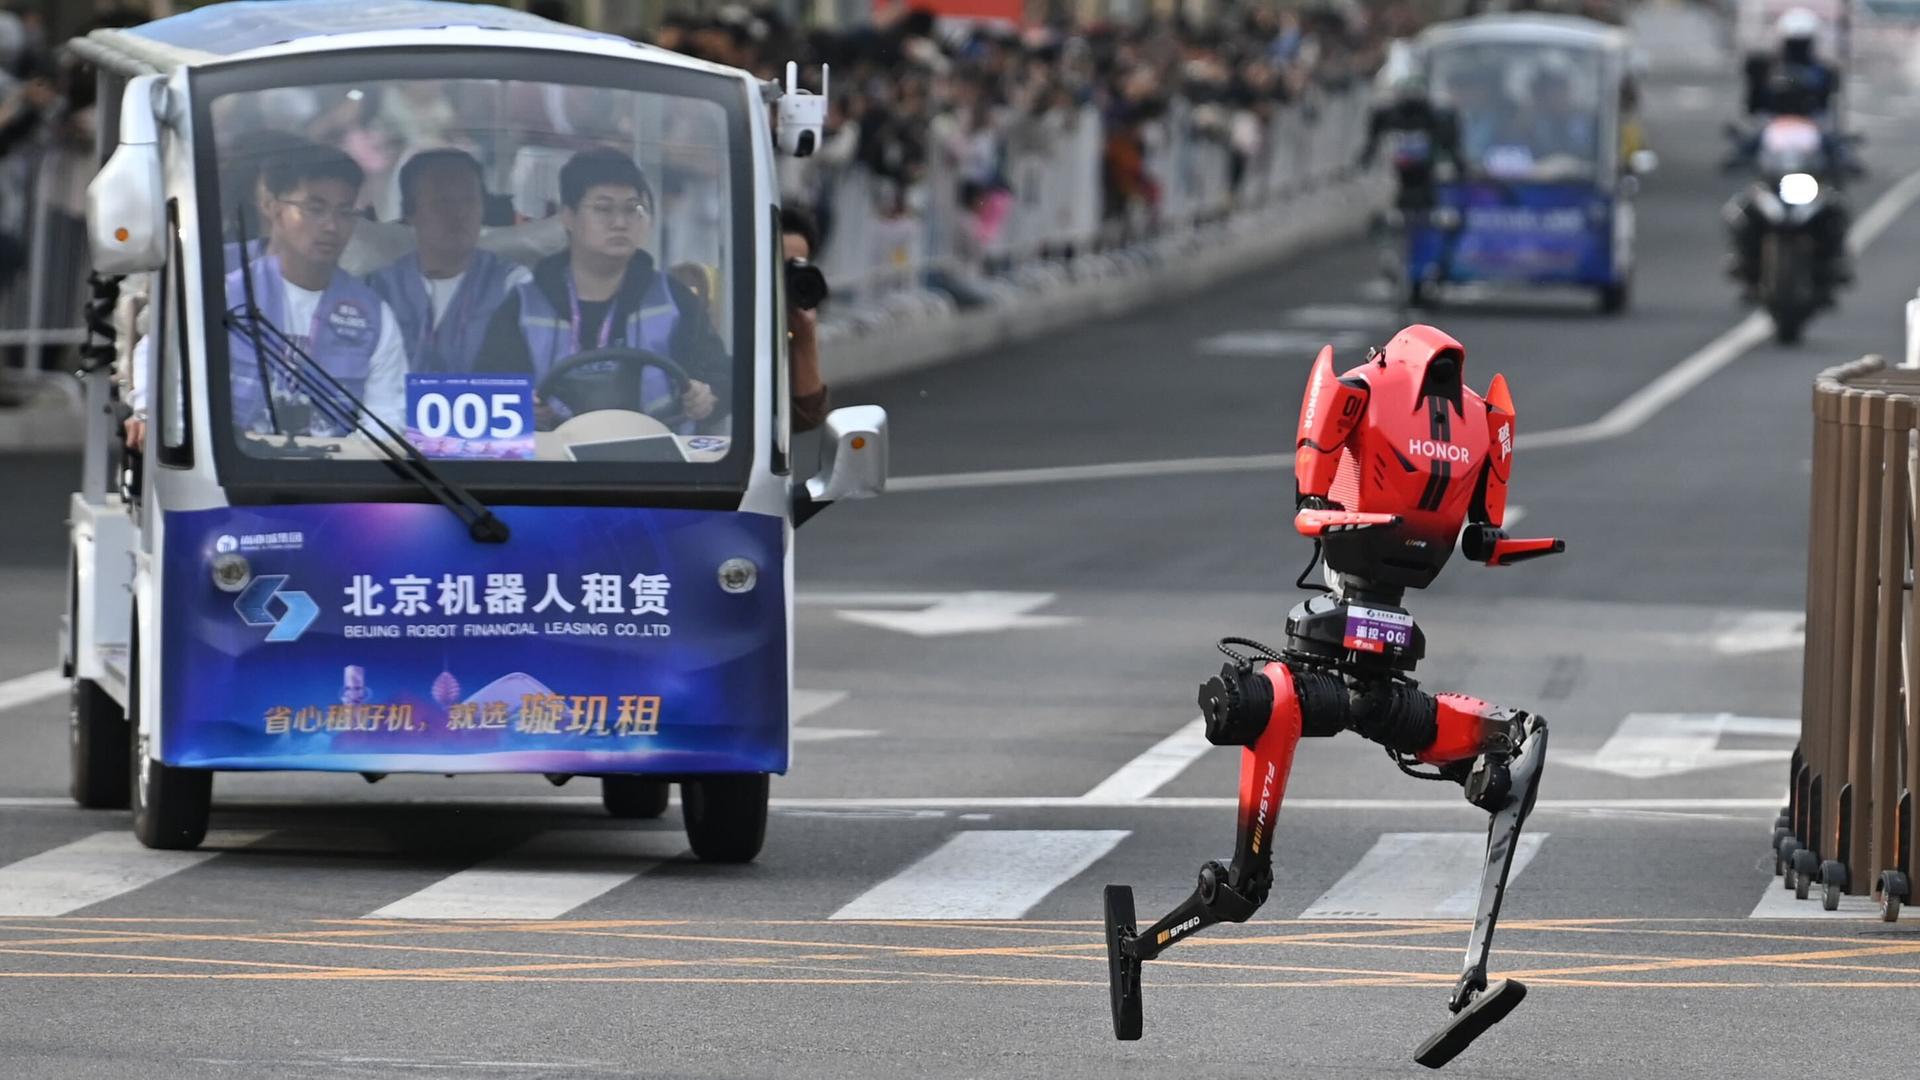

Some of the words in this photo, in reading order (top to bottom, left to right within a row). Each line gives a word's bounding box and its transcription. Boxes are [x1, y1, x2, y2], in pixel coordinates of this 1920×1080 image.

[416, 392, 524, 439] 005
[1303, 371, 1321, 429] HONOR
[1409, 439, 1469, 464] HONOR
[342, 573, 672, 616] 北京机器人租赁
[344, 624, 400, 638] BEIJING
[406, 624, 456, 637] ROBOT
[463, 622, 539, 636] FINANCIAL
[544, 621, 609, 635] LEASING
[1257, 761, 1276, 826] FLASH
[1170, 915, 1200, 938] SPEED
